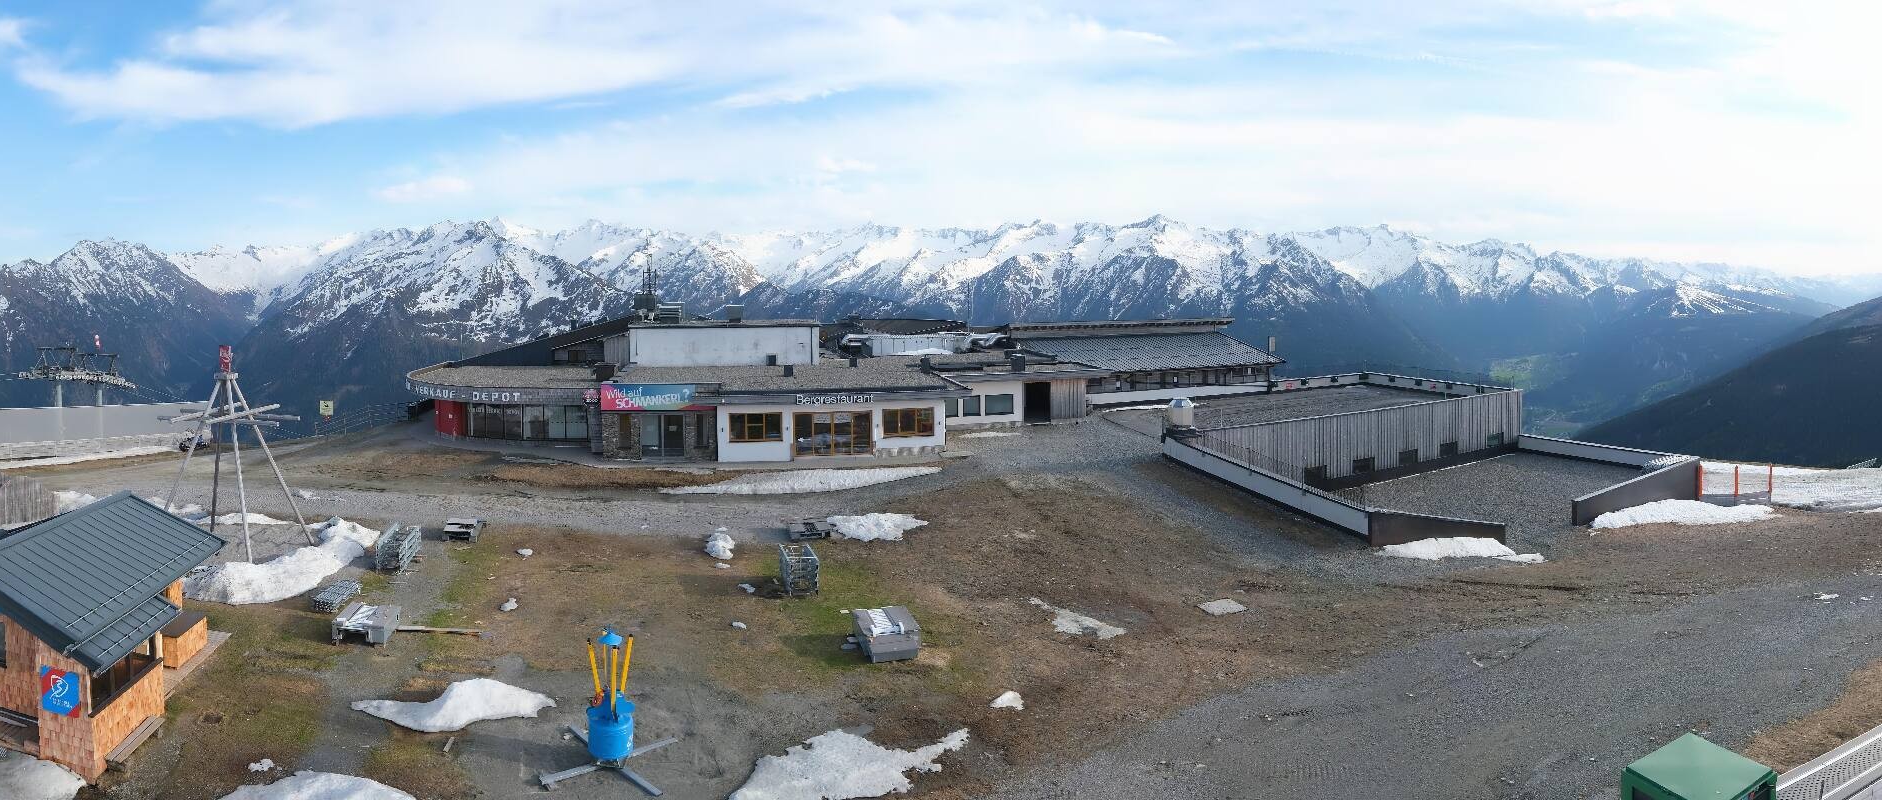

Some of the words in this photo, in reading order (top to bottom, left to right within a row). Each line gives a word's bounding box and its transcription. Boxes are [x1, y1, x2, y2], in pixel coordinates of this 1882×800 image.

[415, 384, 456, 399] VERKAUF
[473, 392, 521, 402] DEPOT
[606, 388, 626, 400] Wild
[628, 386, 643, 398] auf
[796, 394, 874, 406] Bergrestaurant
